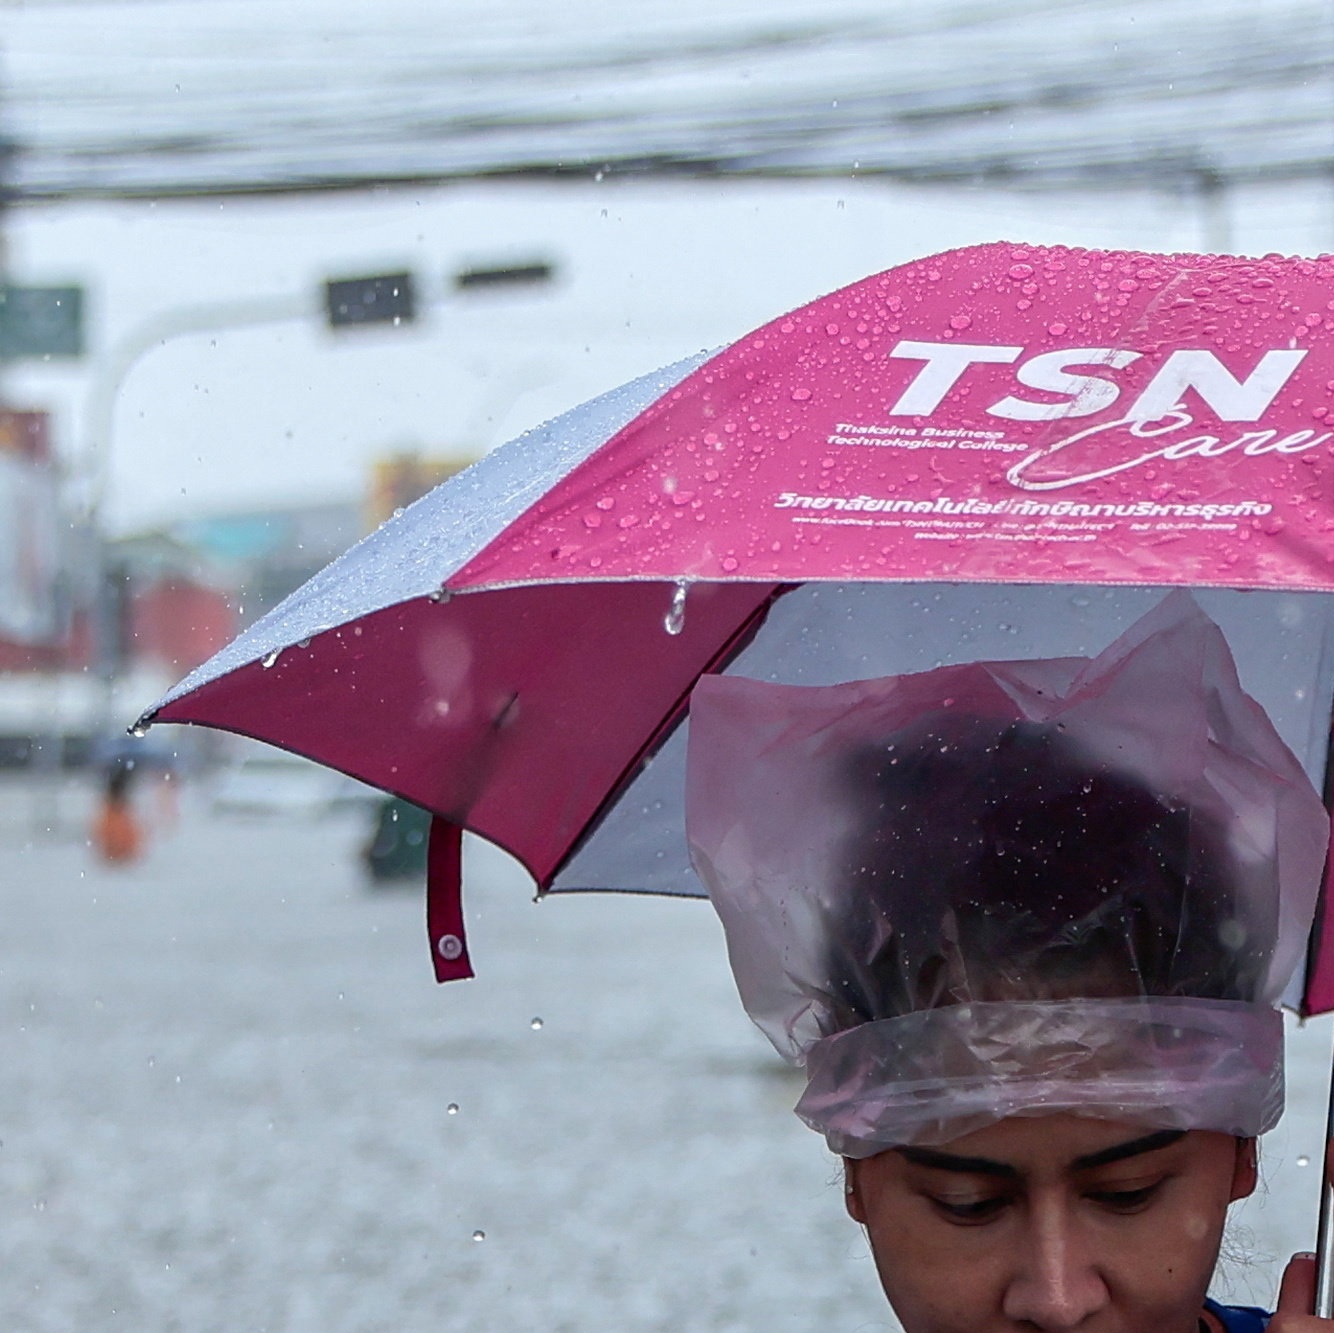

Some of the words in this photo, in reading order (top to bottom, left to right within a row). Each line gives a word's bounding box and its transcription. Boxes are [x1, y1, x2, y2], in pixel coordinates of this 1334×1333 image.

[888, 340, 1308, 422] TSN
[921, 427, 1006, 440] Business
[827, 435, 957, 450] Technological
[958, 440, 1029, 452] College
